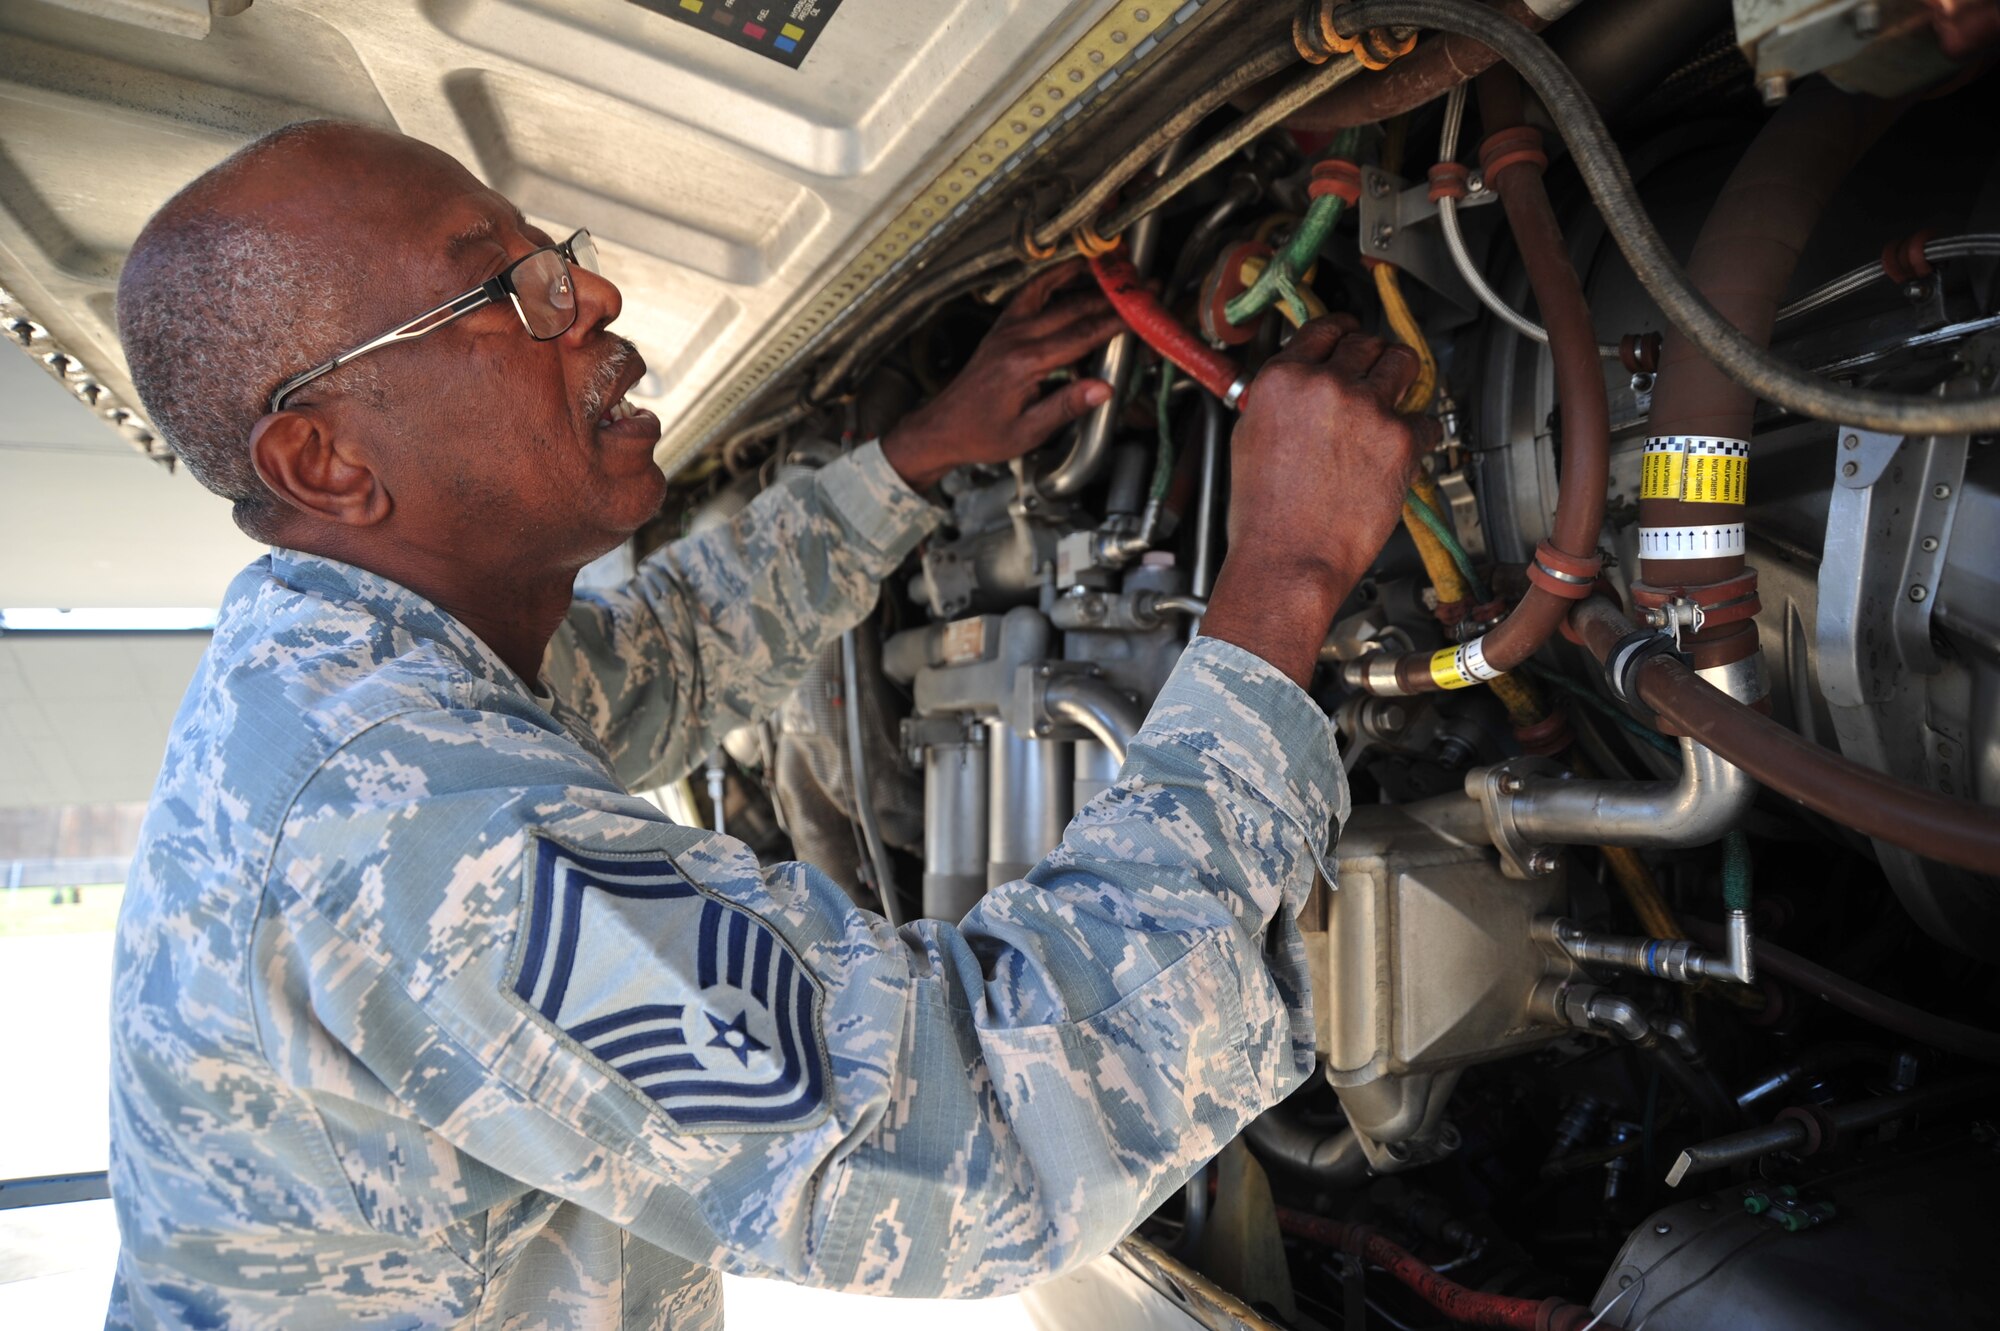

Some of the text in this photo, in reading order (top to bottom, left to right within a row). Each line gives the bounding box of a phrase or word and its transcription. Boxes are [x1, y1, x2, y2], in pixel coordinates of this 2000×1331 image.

[757, 9, 770, 22] FUEL
[1652, 455, 1660, 496] LUBRICATION
[1663, 455, 1671, 496] LUBRICATION
[1696, 459, 1704, 500] LUBRICATION
[1710, 459, 1719, 501] LUBRICATION
[1724, 459, 1732, 501] LUBRICATION
